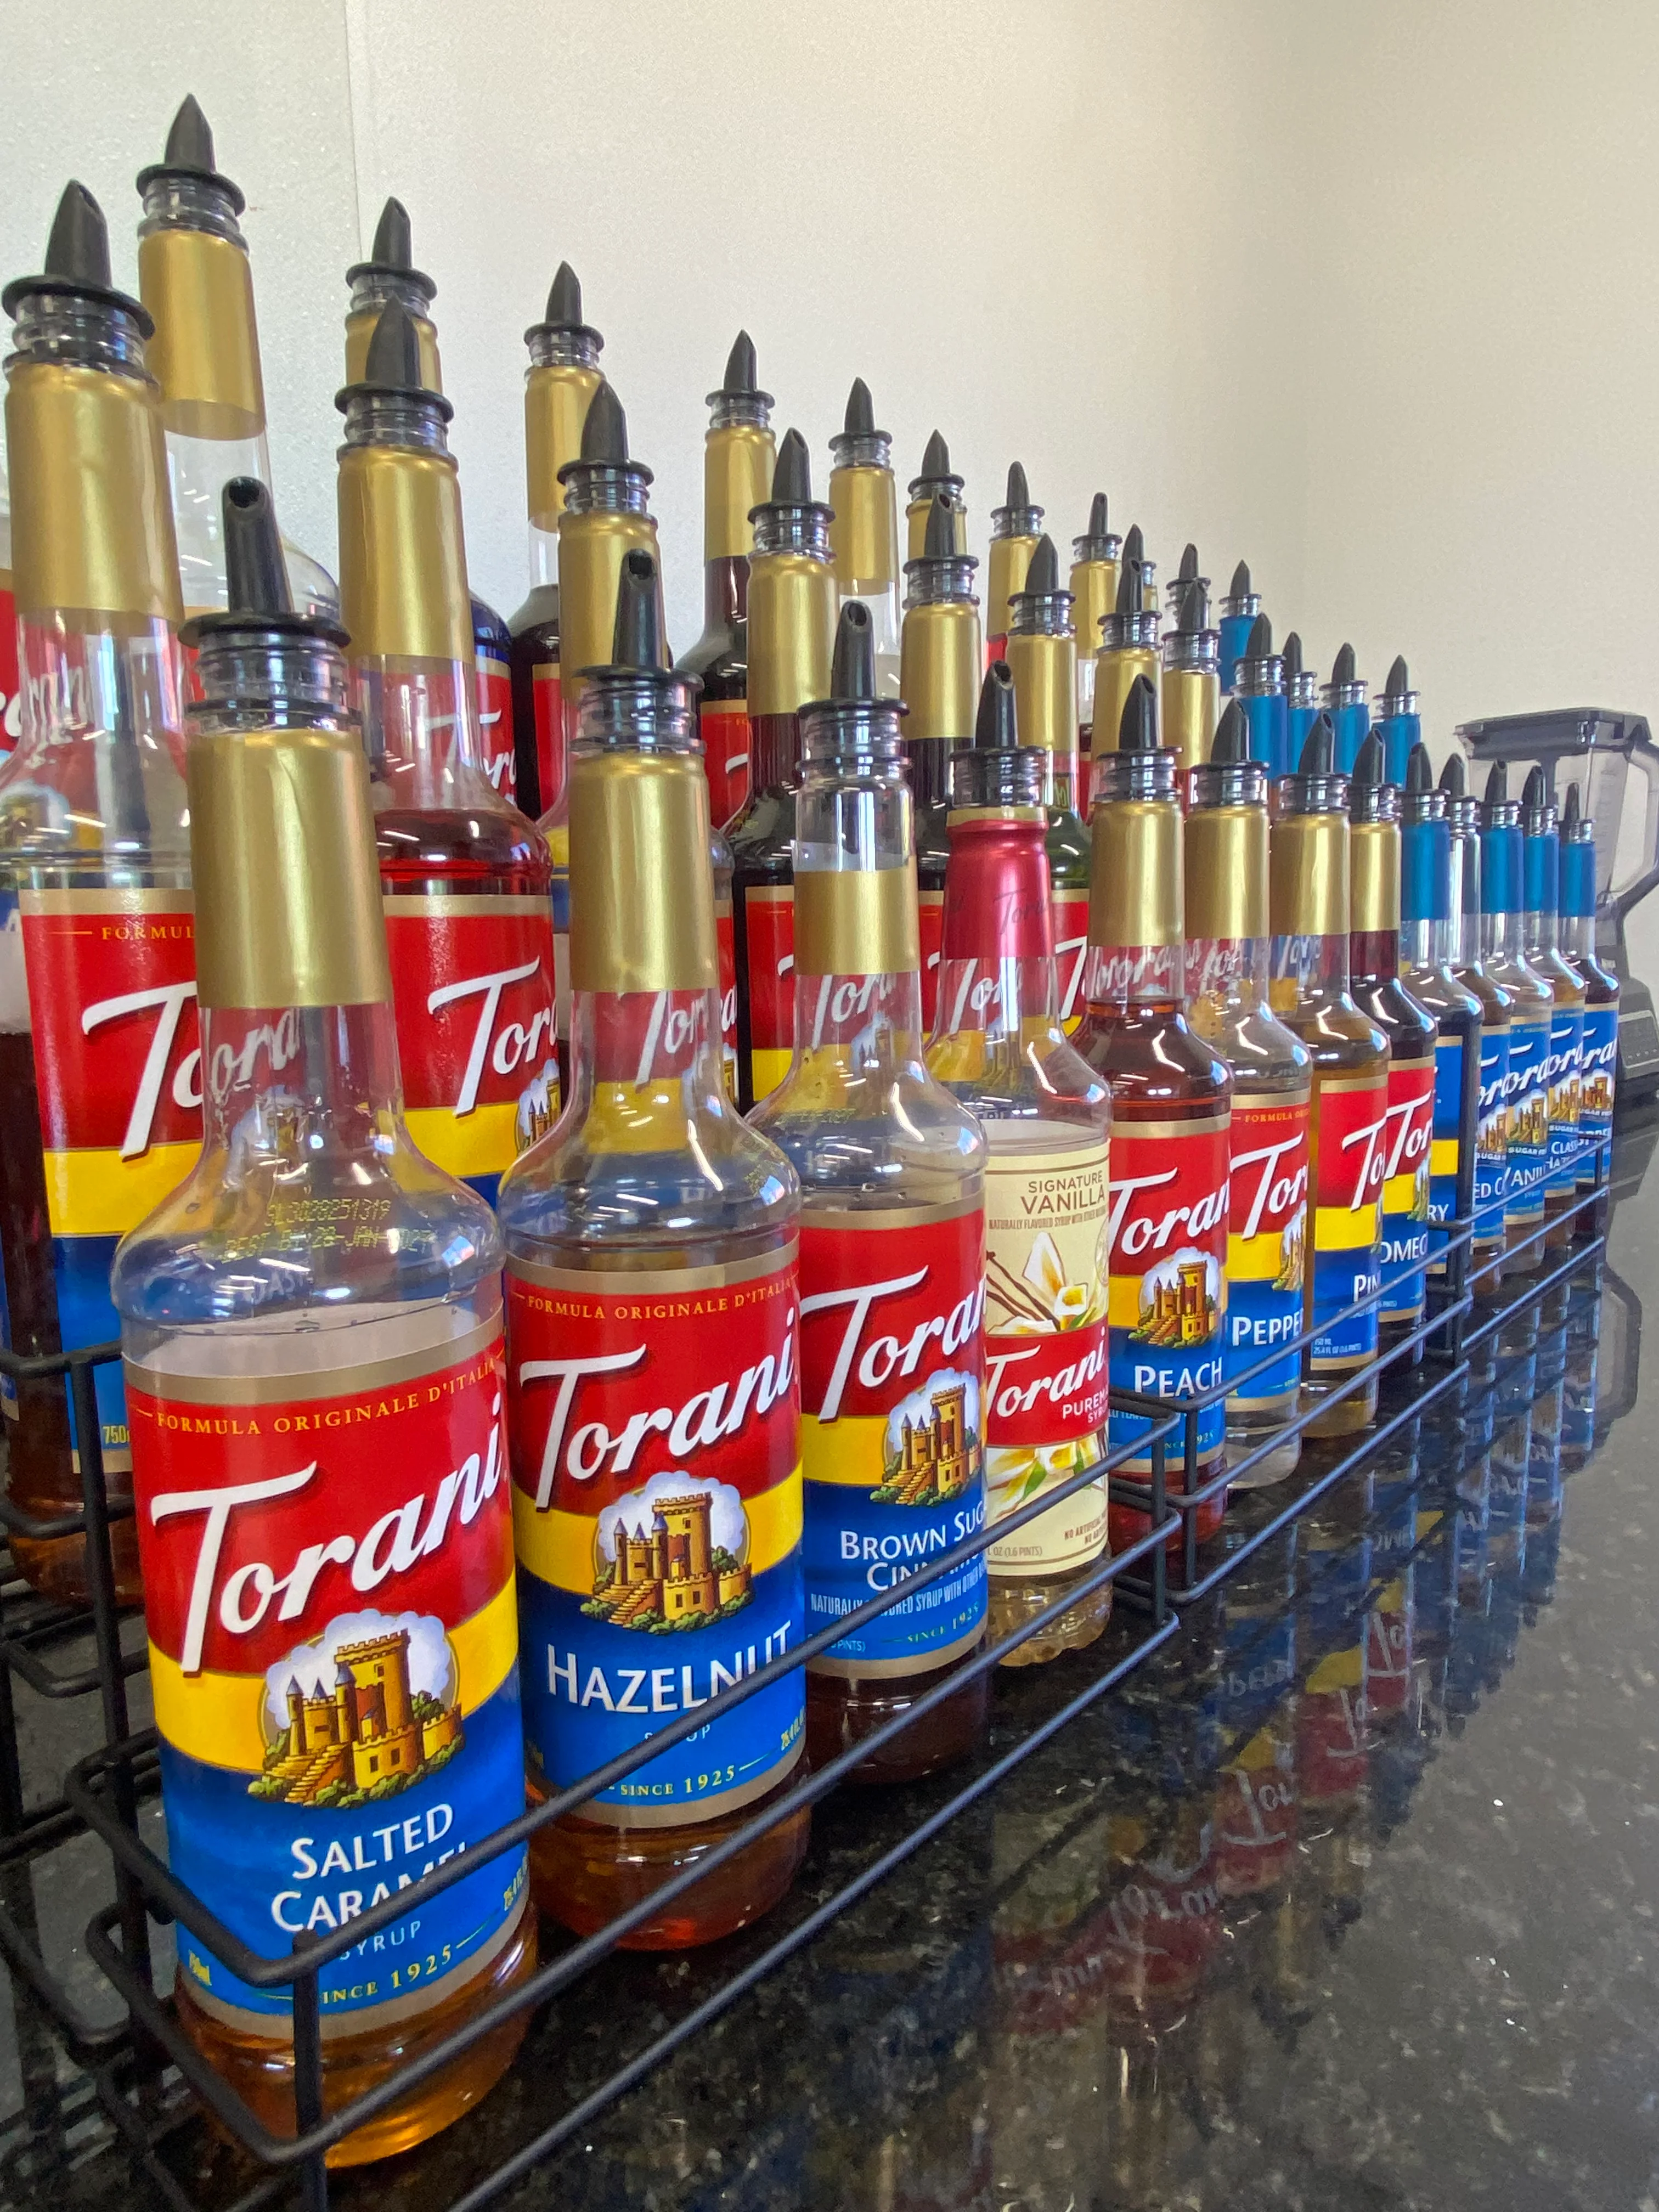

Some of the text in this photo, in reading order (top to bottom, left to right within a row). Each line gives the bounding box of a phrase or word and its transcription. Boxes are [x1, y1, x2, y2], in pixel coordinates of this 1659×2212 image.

[1245, 1112, 1293, 1122] FORMULA
[1020, 1184, 1105, 1215] VANILLA
[1028, 1170, 1103, 1194] SIGNATURE
[527, 1295, 606, 1319] FORMULA
[614, 1297, 728, 1320] ORIGINALE
[986, 1325, 1106, 1418] Torani
[1134, 1356, 1223, 1398] PEACH
[157, 1358, 496, 1435] FORMULA ORIGINALE D'ITALIA
[520, 1307, 796, 1509] Torani
[150, 1392, 504, 1672] Torani
[840, 1525, 946, 1560] BROWN
[620, 1765, 735, 1797] SINCE 1925
[291, 1803, 453, 1880] SALTED
[321, 1948, 452, 2005] INCE 1925
